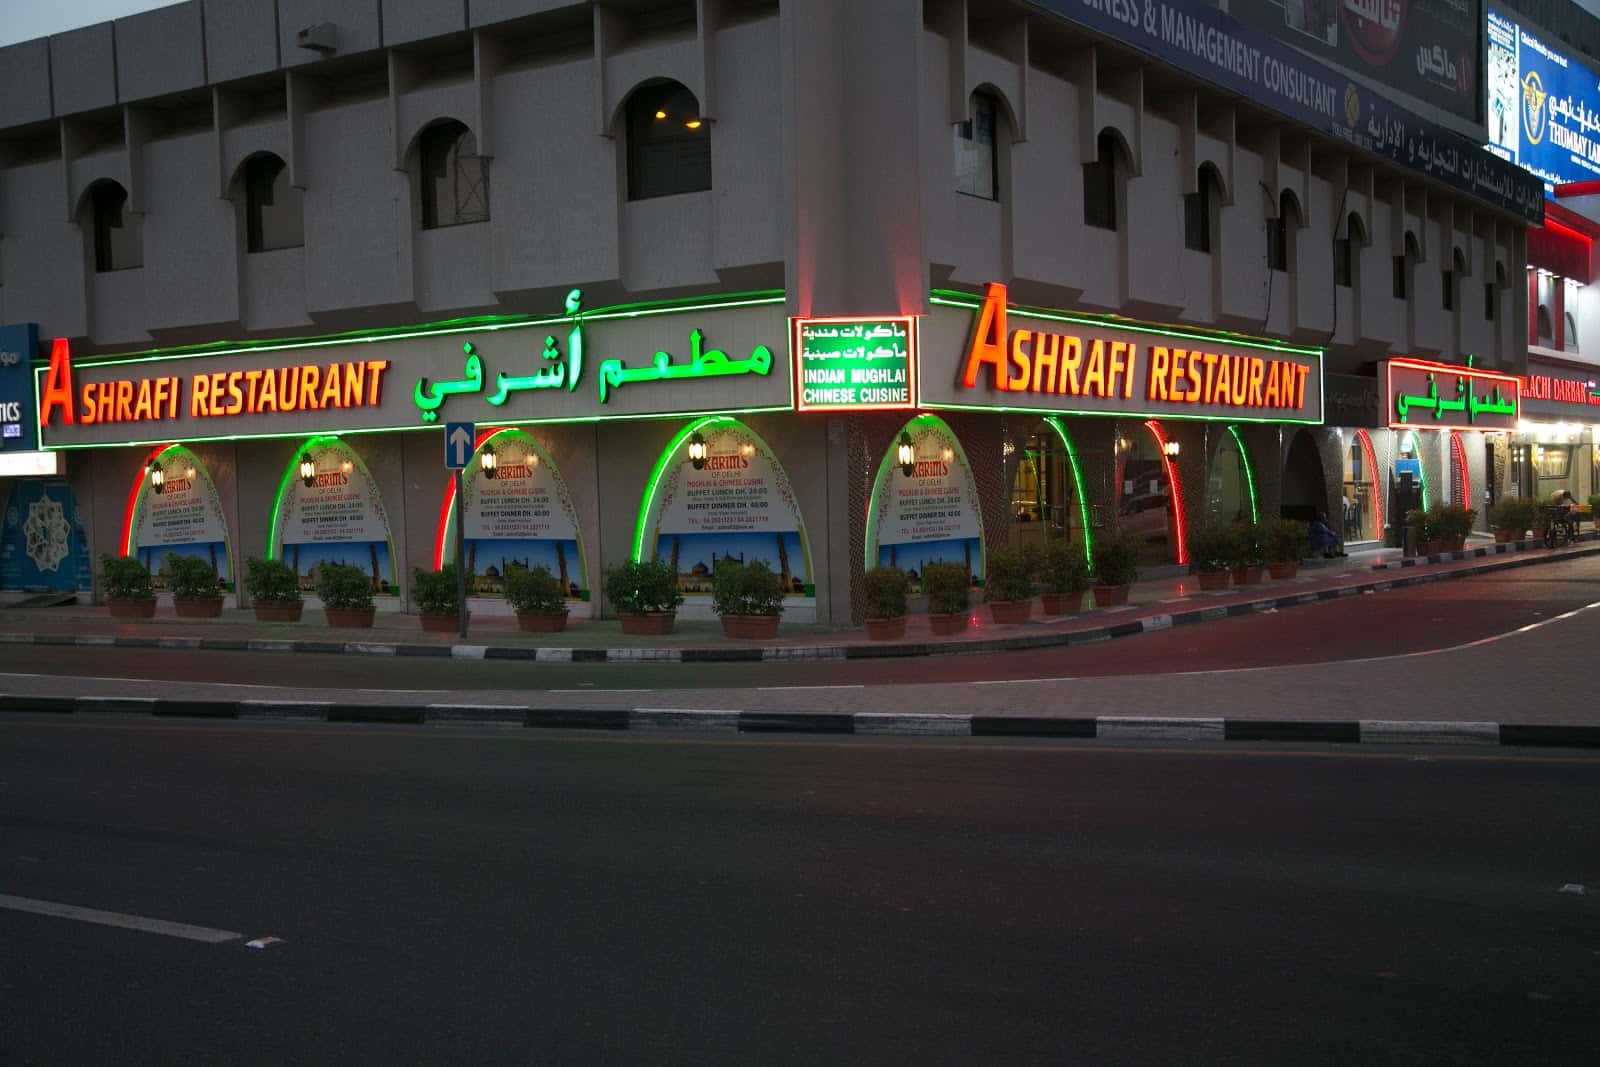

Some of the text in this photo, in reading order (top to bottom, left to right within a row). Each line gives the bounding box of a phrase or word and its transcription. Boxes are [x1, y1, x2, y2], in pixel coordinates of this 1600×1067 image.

[1144, 0, 1157, 37] &
[1161, 3, 1260, 84] MANAGEMENT
[1263, 55, 1336, 119] CONSULTANT
[803, 326, 839, 341] هندية
[414, 288, 773, 422] مطعم أشرفي
[803, 347, 841, 361] صينية
[963, 282, 1310, 410] ASHRAFI RESTAURANT
[40, 337, 390, 427] ASHRAFI RESTAURANT
[804, 368, 906, 384] INDIAN MUGHLAI
[1519, 375, 1551, 399] ACHI
[803, 387, 909, 403] CHINESE CUISINE
